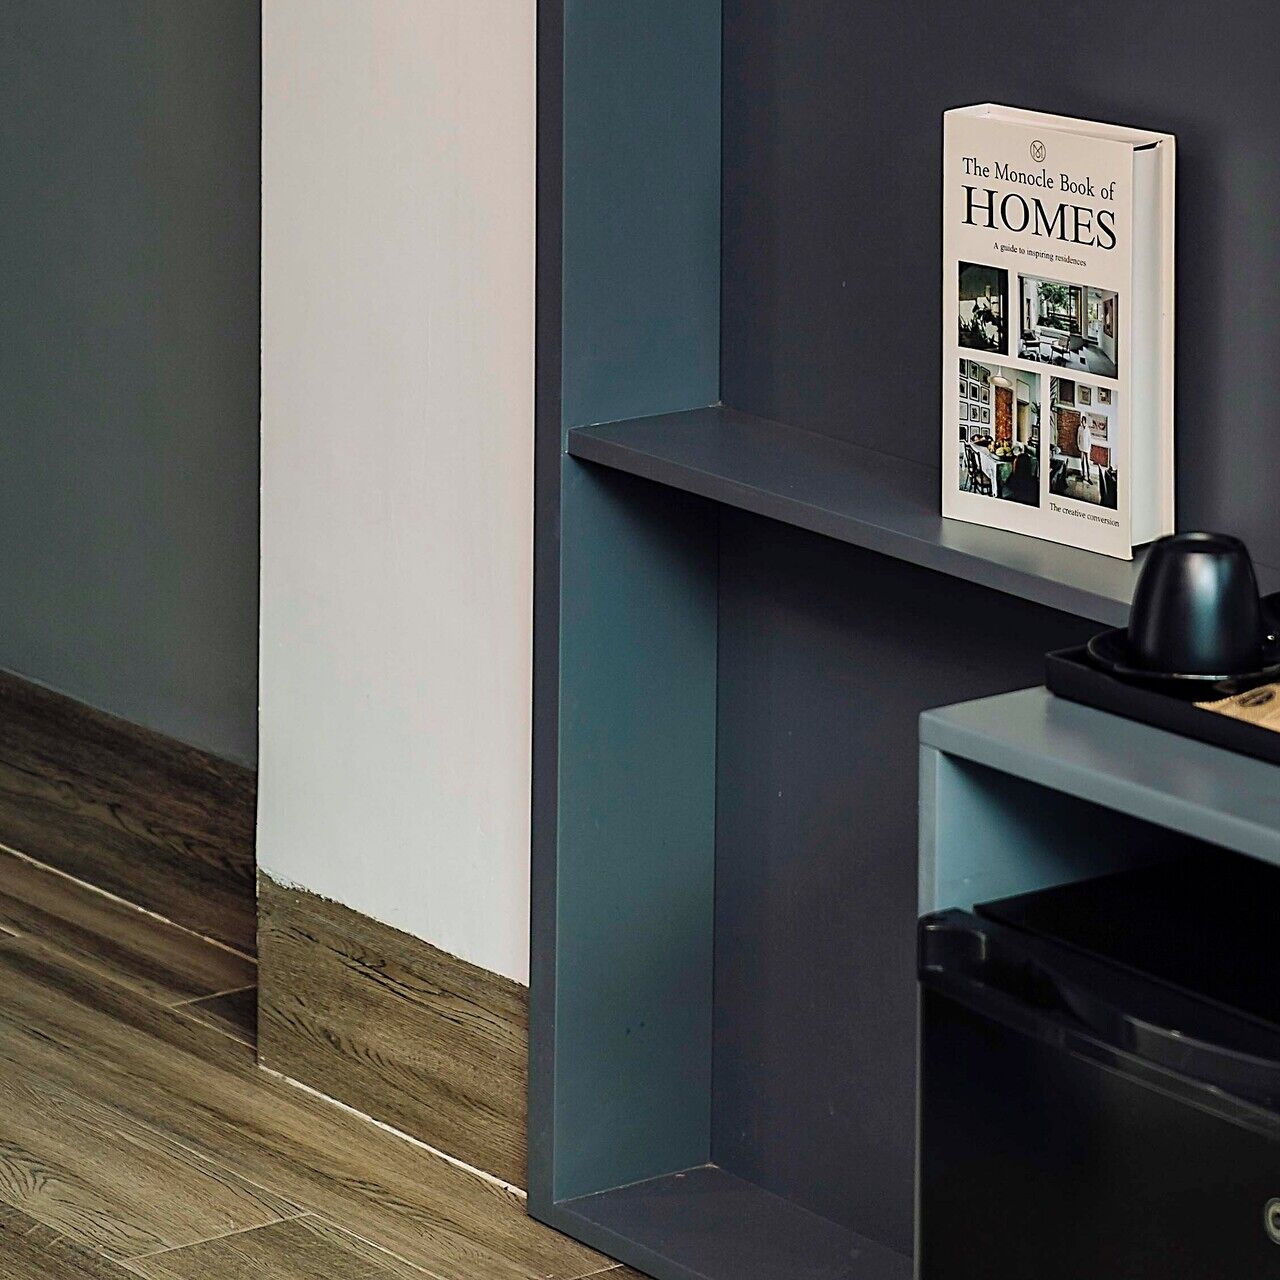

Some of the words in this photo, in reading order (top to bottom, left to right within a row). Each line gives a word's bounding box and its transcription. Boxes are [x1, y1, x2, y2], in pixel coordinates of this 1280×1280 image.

[962, 157, 990, 178] The
[994, 161, 1054, 189] Monocle
[1059, 173, 1095, 197] Book
[1100, 181, 1117, 201] of
[961, 184, 1117, 251] HOMES
[993, 242, 999, 250] A
[1000, 243, 1018, 253] guide
[1026, 249, 1054, 262] inspiring
[1055, 254, 1087, 267] residences
[1049, 502, 1061, 512] The
[1062, 507, 1086, 518] creative
[1087, 513, 1120, 527] conversion
